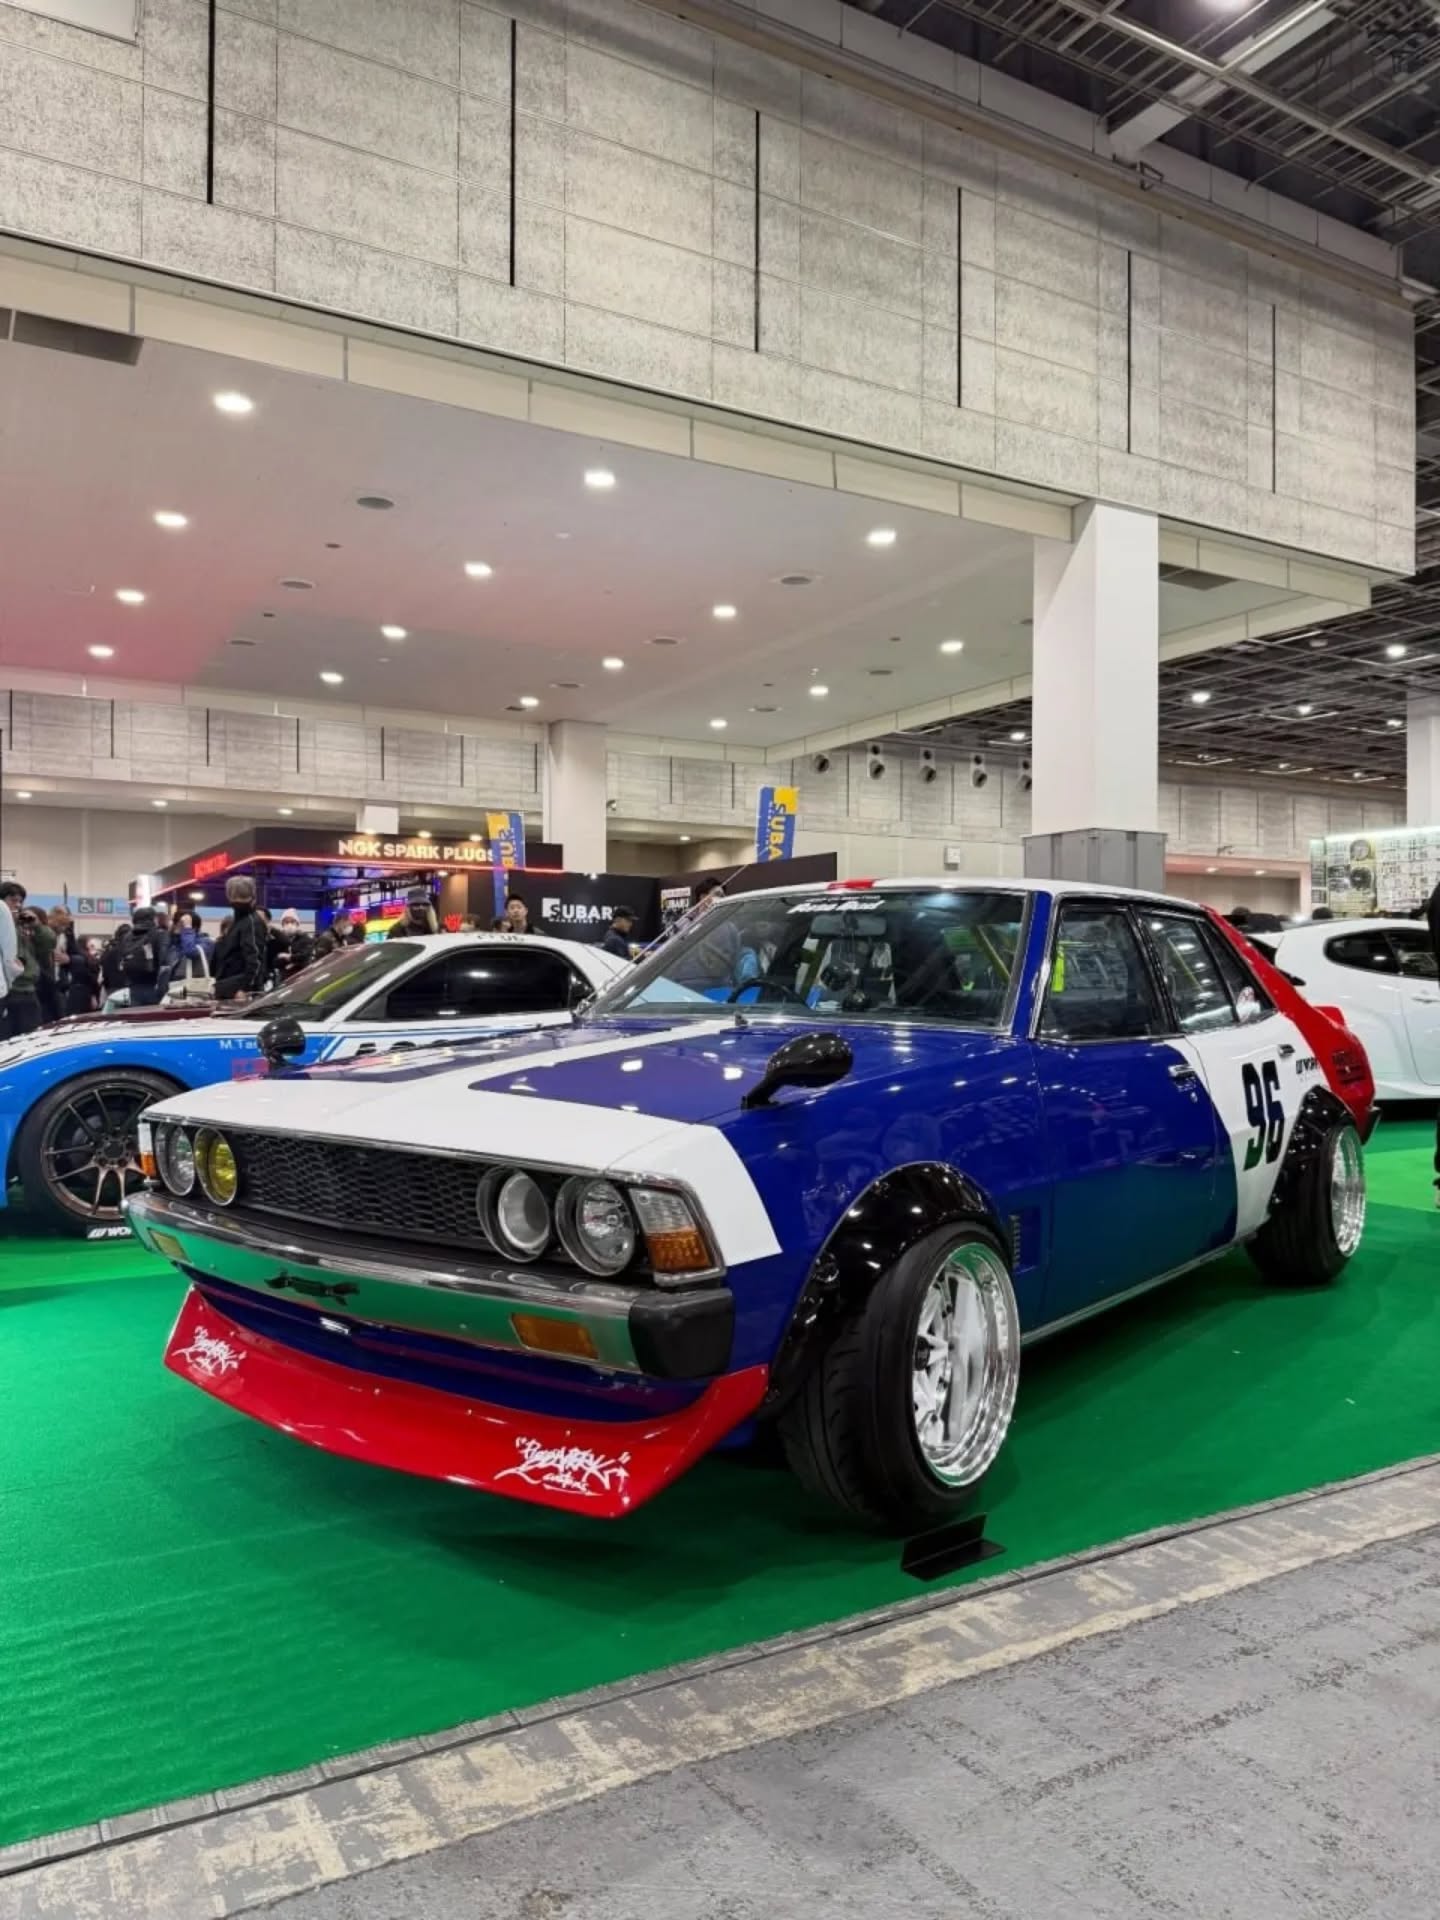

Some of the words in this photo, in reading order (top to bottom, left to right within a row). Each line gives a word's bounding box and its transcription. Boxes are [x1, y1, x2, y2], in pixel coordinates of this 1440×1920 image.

[338, 840, 381, 857] NGK
[383, 844, 441, 860] SPARK
[443, 847, 493, 862] PLUGS
[549, 902, 617, 920] SUBAR
[1242, 1060, 1285, 1171] 96
